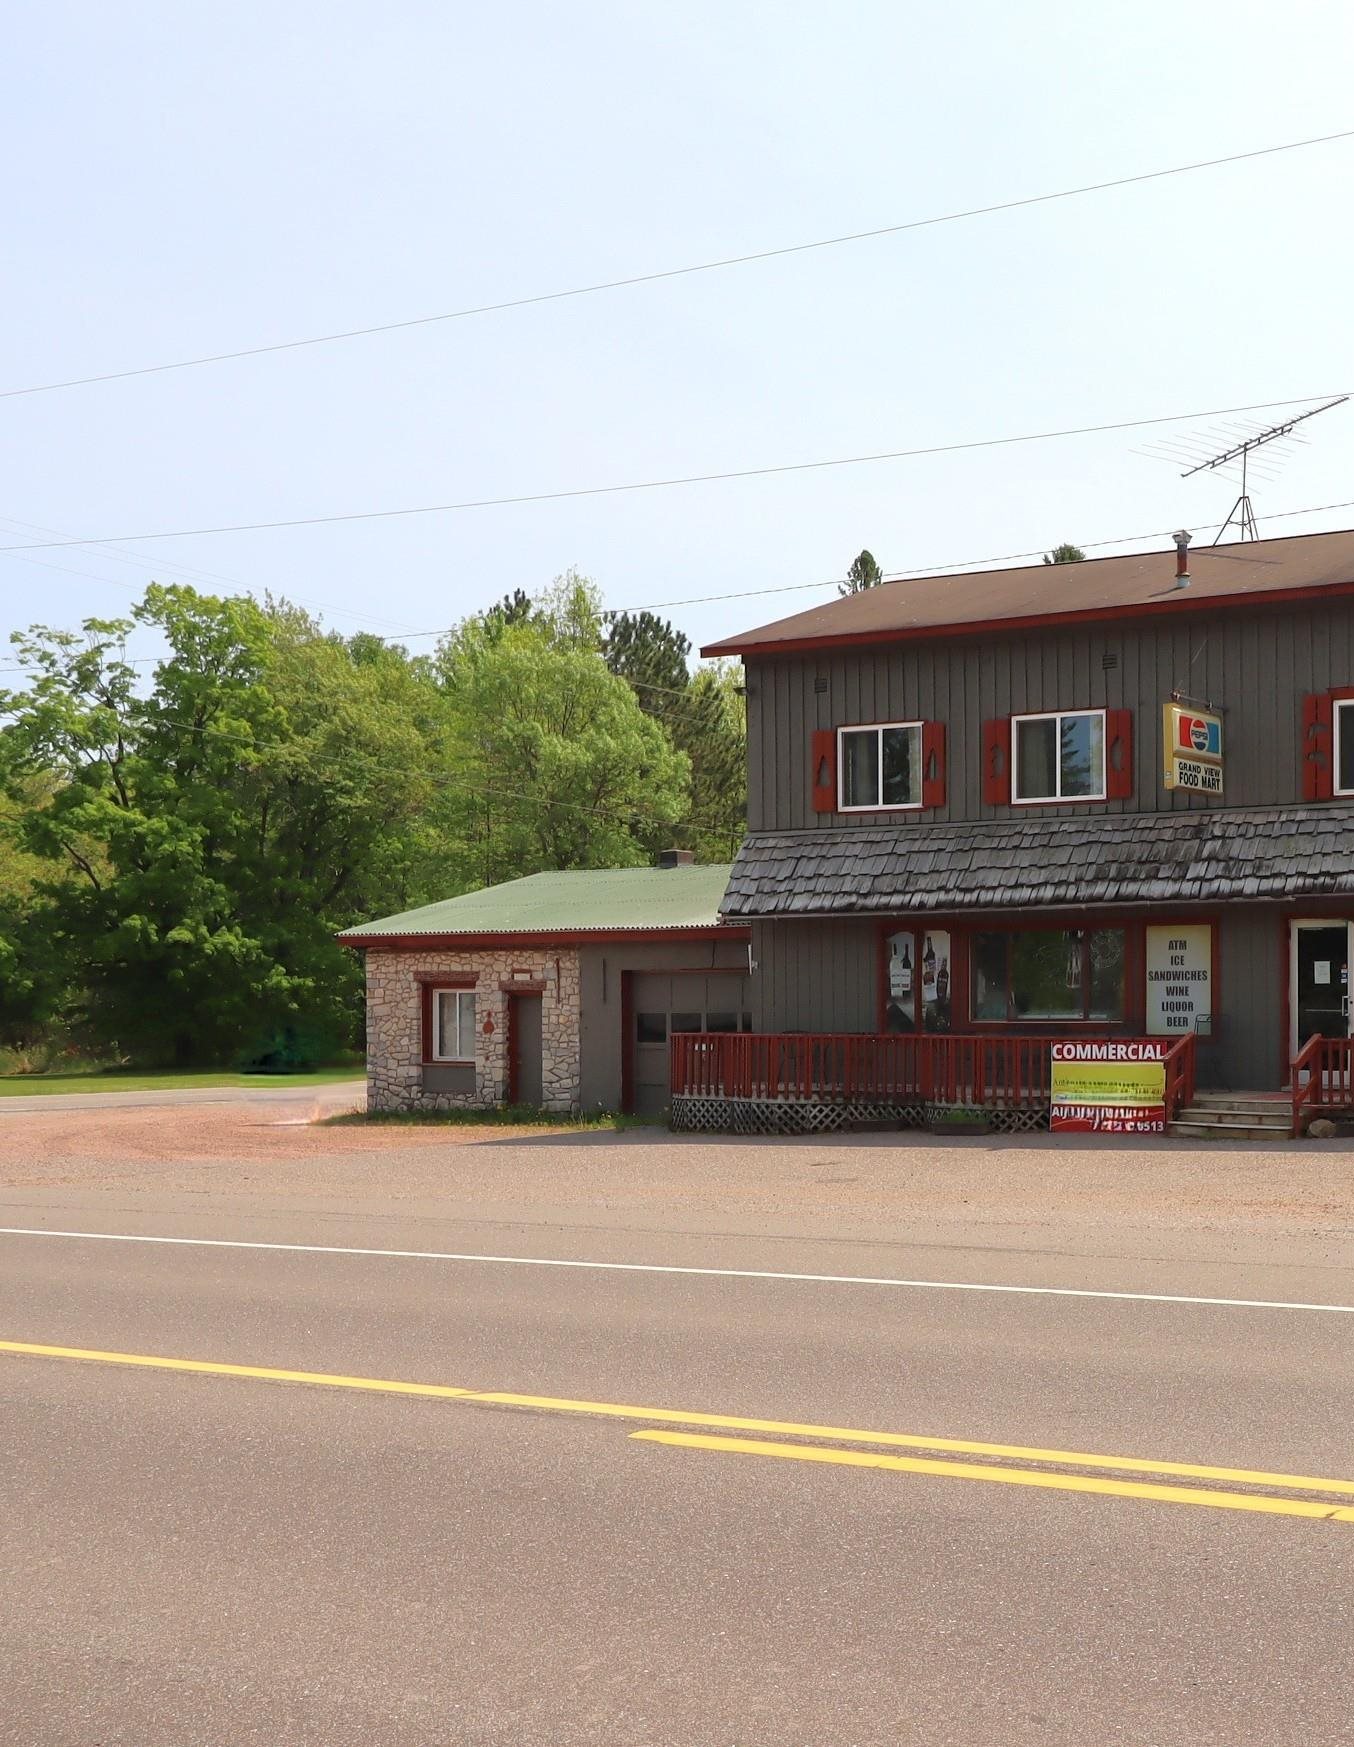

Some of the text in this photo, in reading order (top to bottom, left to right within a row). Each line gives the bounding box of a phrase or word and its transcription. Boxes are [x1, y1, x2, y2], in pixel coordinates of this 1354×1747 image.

[1178, 762, 1220, 777] GRAND VIEW
[1179, 772, 1220, 790] FOOD MART
[1168, 940, 1187, 950] ATM
[1170, 955, 1184, 966] ICE
[1148, 970, 1208, 981] SANDWICHES
[1166, 986, 1190, 996] WINE
[1161, 1001, 1194, 1013] LIQUOR
[1166, 1016, 1189, 1027] BEER
[1052, 1043, 1164, 1060] COMMERCIAL
